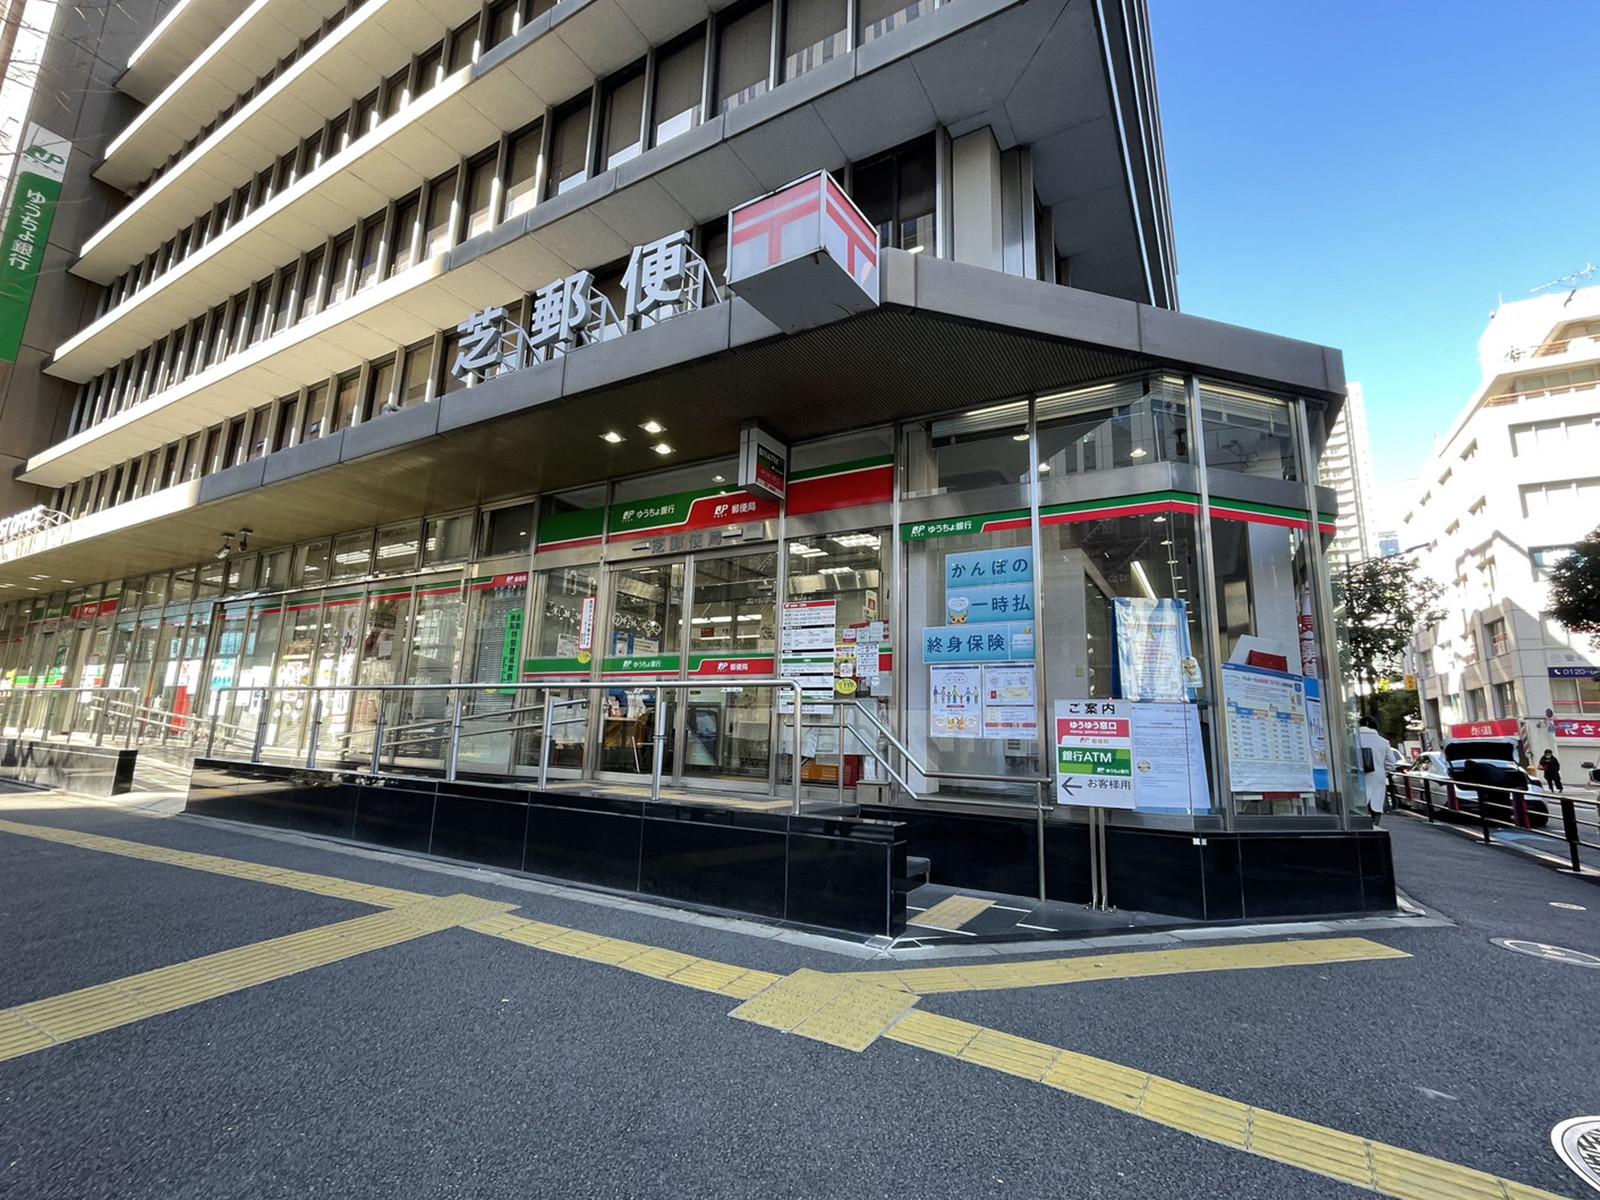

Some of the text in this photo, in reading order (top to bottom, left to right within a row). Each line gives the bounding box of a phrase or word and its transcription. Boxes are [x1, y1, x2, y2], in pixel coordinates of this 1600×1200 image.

[8, 189, 46, 270] ゆうちょ銀行
[636, 504, 675, 519] ゆうちょ銀行
[731, 501, 757, 514] 郵便局
[927, 521, 972, 533] ゆうちょ銀行
[652, 531, 722, 553] 芝郵便局
[952, 559, 1028, 578] かんぽの
[971, 594, 1030, 613] 一時払
[927, 634, 1005, 654] 終身保険
[633, 659, 661, 668] ゆうちょ銀行
[730, 663, 748, 671] 郵便局
[1069, 703, 1115, 715] ご案内
[1069, 721, 1117, 730] ゆうゆう窓口
[1062, 750, 1112, 763] 銀行ATM
[1087, 779, 1131, 790] お客様用
